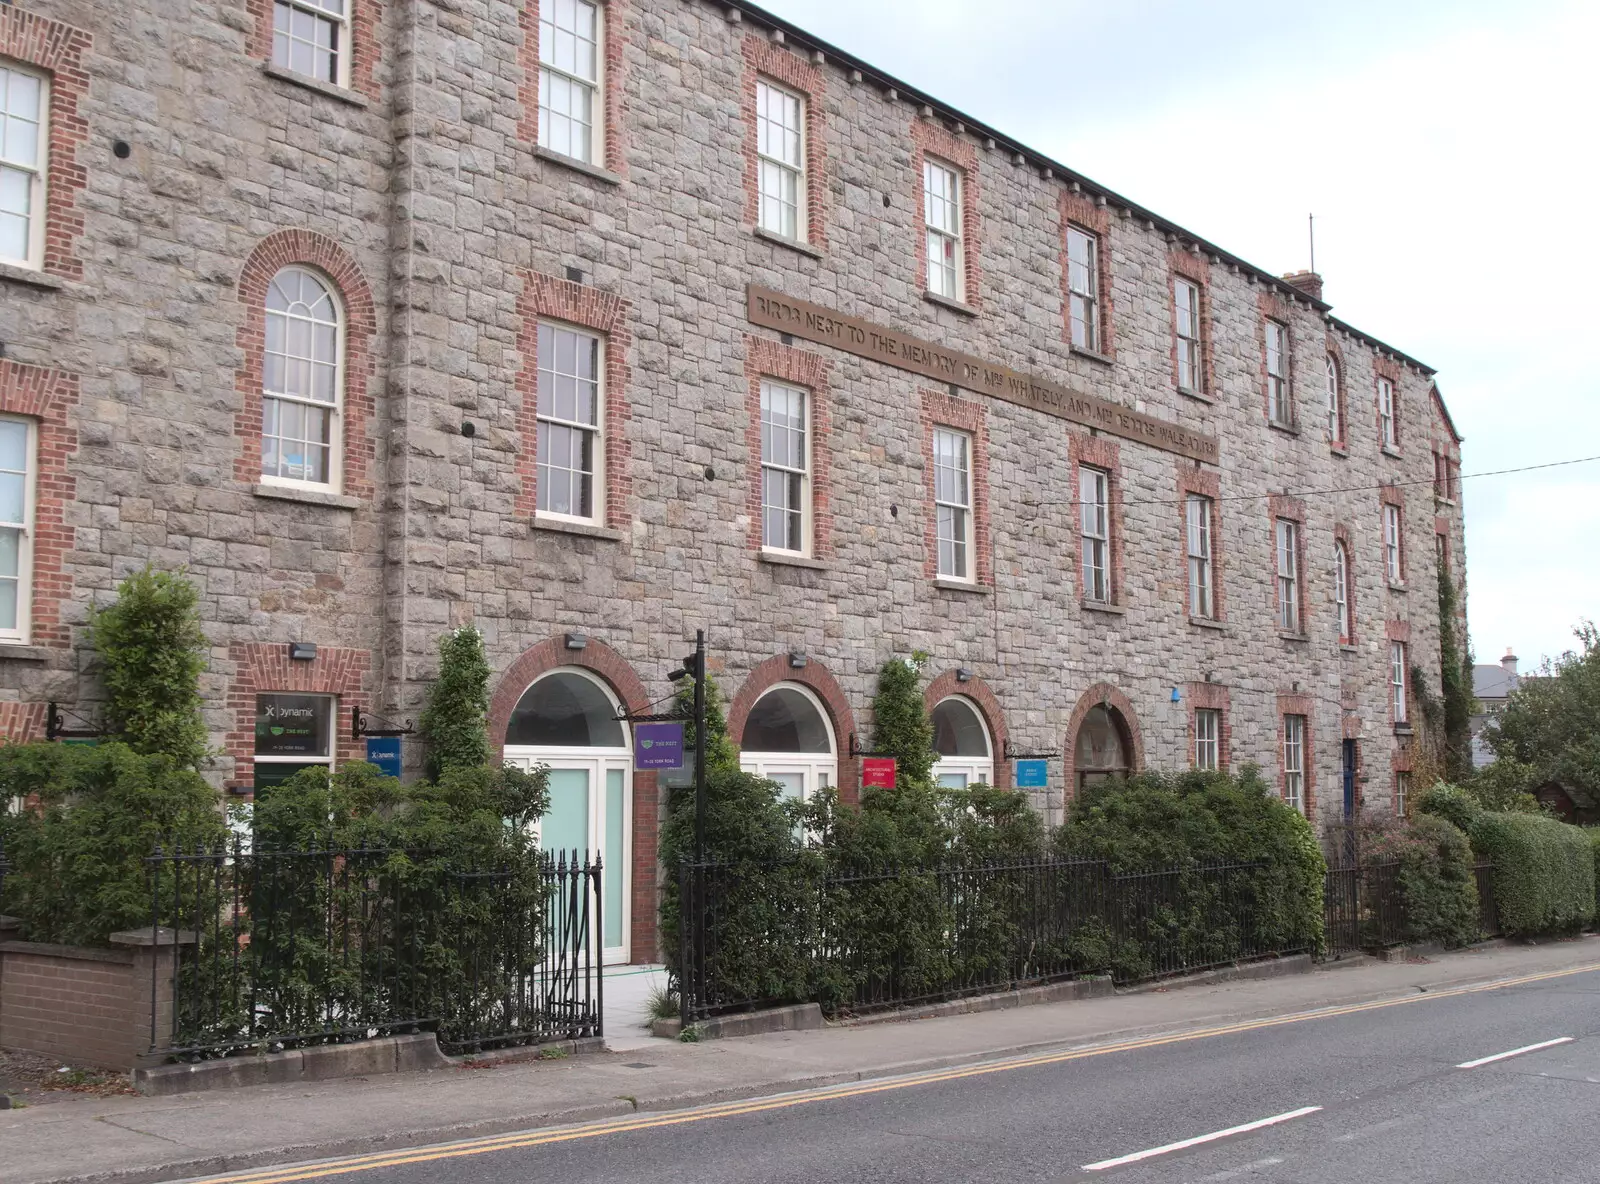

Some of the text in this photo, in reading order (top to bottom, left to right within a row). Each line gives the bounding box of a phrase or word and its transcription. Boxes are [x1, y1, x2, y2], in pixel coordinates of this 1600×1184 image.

[805, 311, 843, 337] NEST
[848, 325, 866, 345] TO
[870, 331, 897, 356] THE
[902, 343, 958, 375] MEMORY
[964, 362, 979, 382] OF
